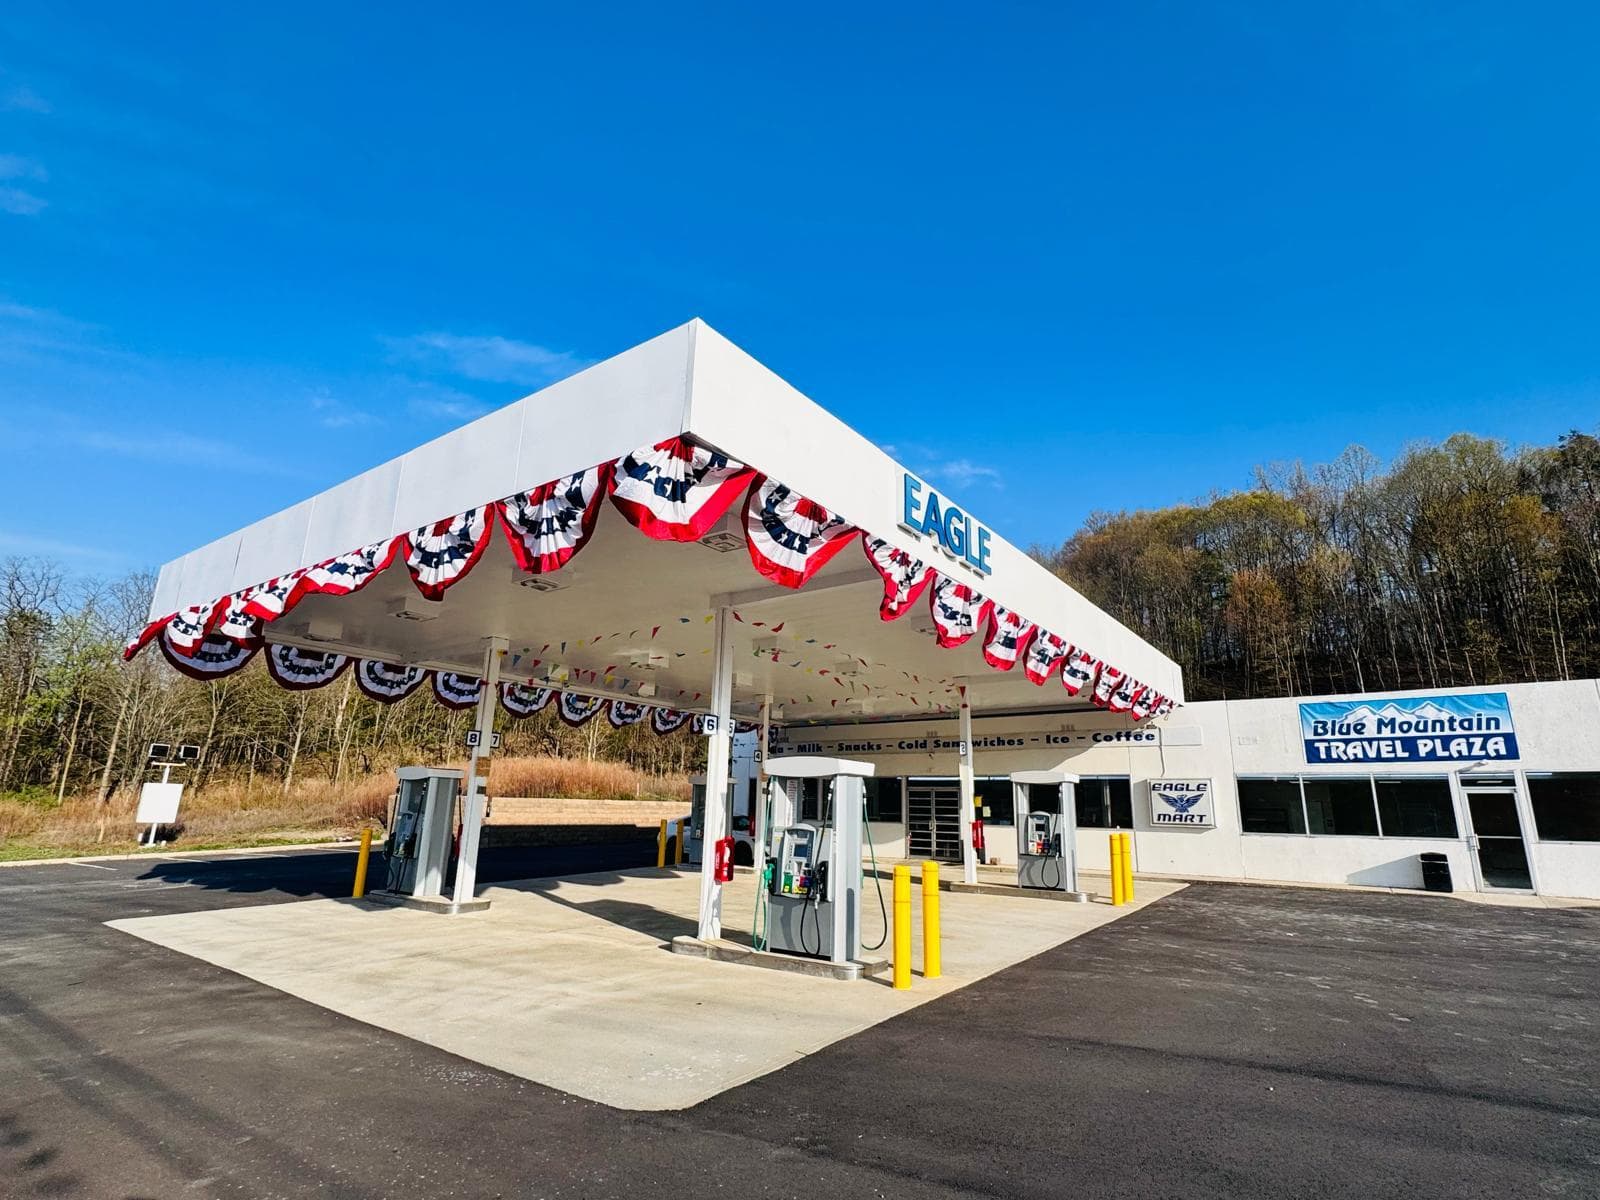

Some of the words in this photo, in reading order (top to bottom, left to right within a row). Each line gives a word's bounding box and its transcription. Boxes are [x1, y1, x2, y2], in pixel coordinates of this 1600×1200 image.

[904, 473, 992, 576] EAGLE
[706, 719, 715, 731] 6
[1313, 720, 1367, 736] Blue
[1376, 712, 1501, 735] Mountain
[469, 733, 478, 743] 8
[492, 735, 499, 745] 7
[797, 743, 823, 753] Milk
[837, 742, 882, 752] Snacks
[898, 740, 927, 750] Cold
[933, 737, 1024, 749] Sanwiches
[1045, 734, 1070, 744] Ice
[1092, 731, 1155, 743] Coffee
[1314, 740, 1409, 761] TRAVEL
[1416, 737, 1508, 758] PLAZA
[1152, 783, 1207, 792] EAGLE
[1157, 813, 1207, 823] MART
